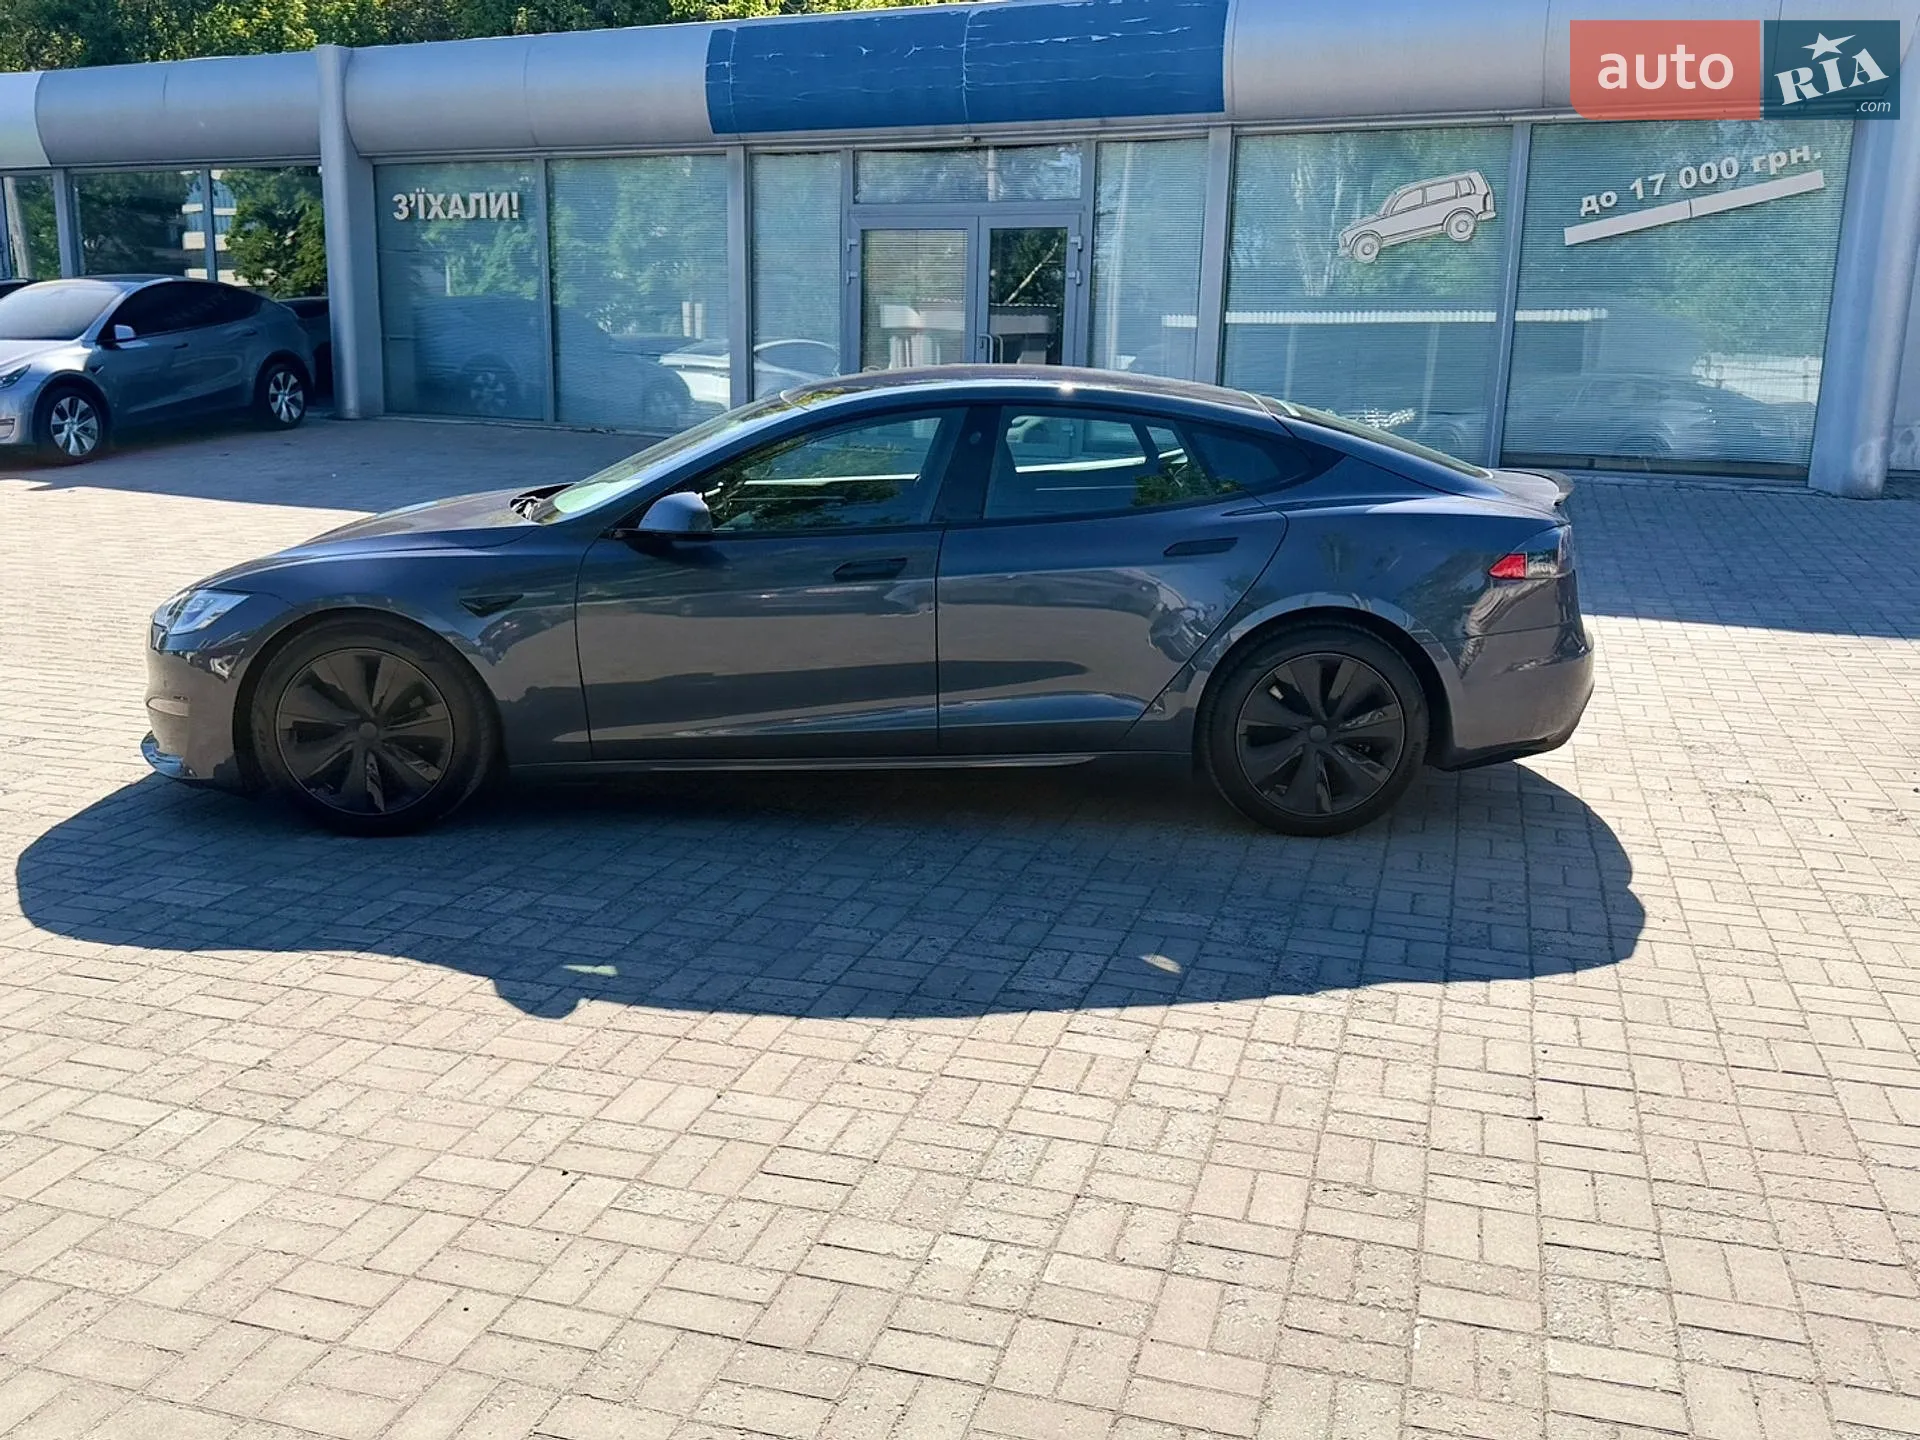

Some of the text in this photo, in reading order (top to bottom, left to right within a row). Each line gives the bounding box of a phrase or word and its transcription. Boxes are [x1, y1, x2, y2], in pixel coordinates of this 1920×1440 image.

[1580, 145, 1822, 216] до 17 000 грн.
